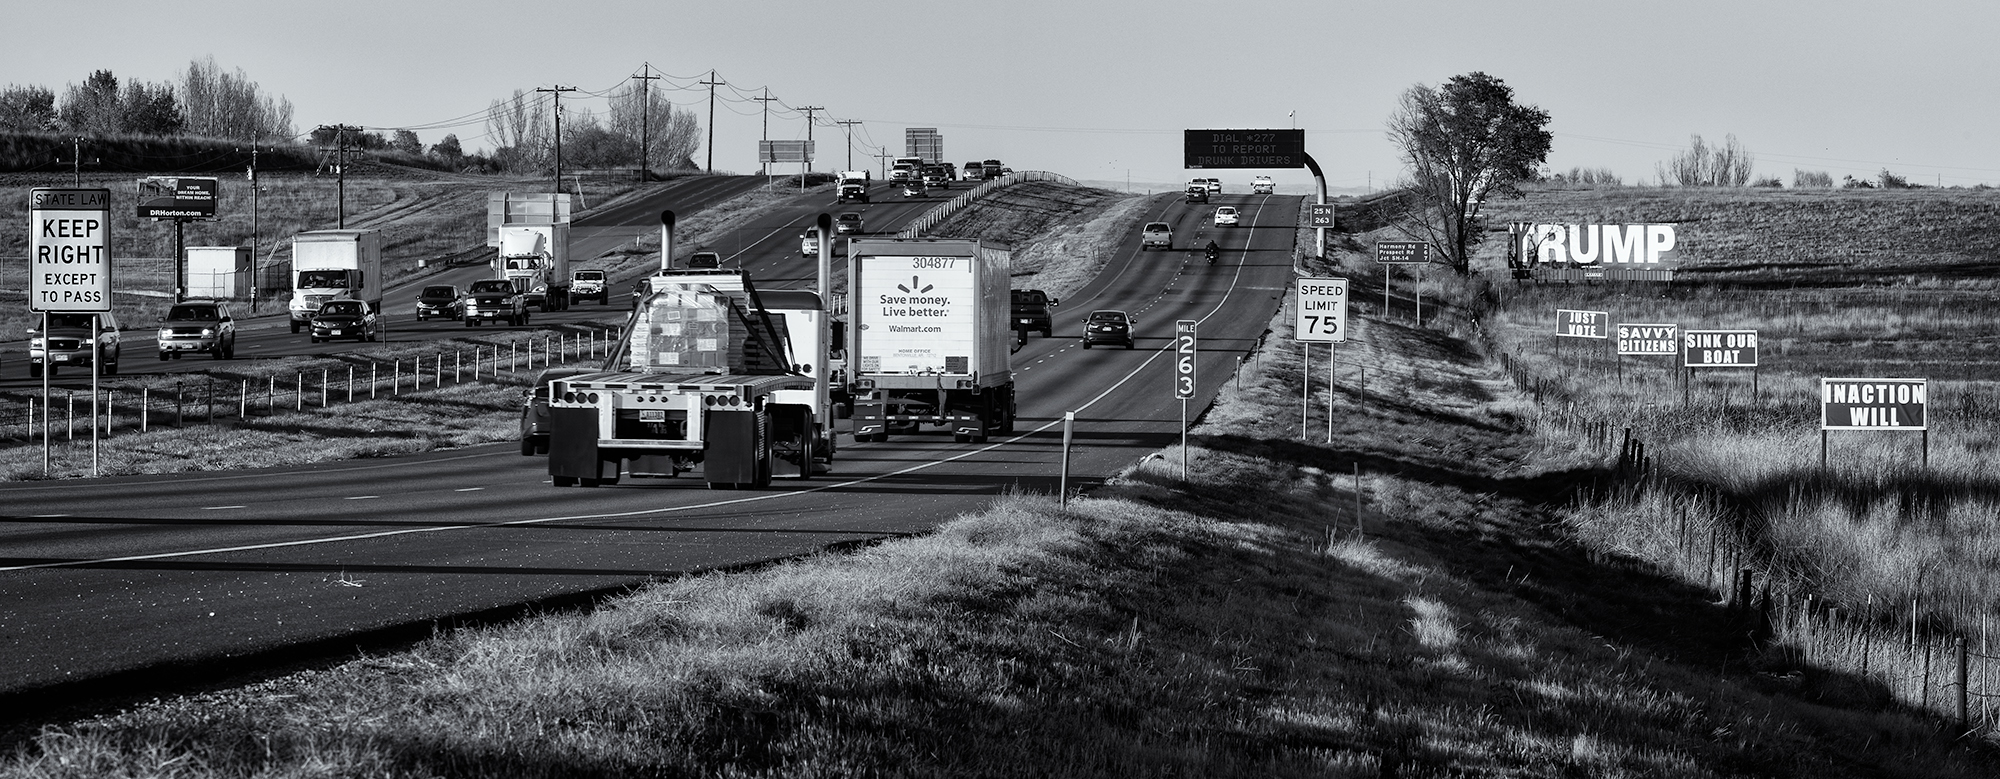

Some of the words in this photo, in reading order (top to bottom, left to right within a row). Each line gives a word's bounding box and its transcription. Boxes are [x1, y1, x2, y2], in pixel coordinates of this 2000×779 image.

[1212, 134, 1239, 142] DIAL
[1212, 145, 1226, 153] TO
[1233, 145, 1276, 153] REPORT
[1198, 156, 1234, 165] DRUNK
[1241, 156, 1290, 164] DRIVERS
[35, 193, 75, 205] STATE
[81, 193, 107, 205] LAW
[1315, 216, 1330, 224] 263
[43, 219, 99, 238] KEEP
[38, 245, 104, 264] RIGHT
[912, 257, 956, 269] 304877
[45, 273, 97, 285] EXCEPT
[41, 291, 58, 303] TO
[64, 291, 102, 303] PASS
[1301, 286, 1343, 296] SPEED
[880, 294, 907, 305] Save
[909, 296, 951, 307] money.
[1305, 301, 1338, 311] LIMIT
[883, 307, 907, 317] Live
[909, 307, 948, 317] better.
[1569, 312, 1597, 324] JUST
[888, 325, 942, 333] Walmart.com
[1178, 325, 1195, 333] MILE
[1304, 316, 1338, 334] 75
[1568, 325, 1597, 336] VOTE
[1619, 328, 1675, 338] SAVVY
[1620, 340, 1675, 351] CITIZENS
[1687, 334, 1721, 348] SINK
[1727, 334, 1756, 348] OUR
[1704, 350, 1740, 363] BOAT
[1178, 335, 1194, 395] 263
[1826, 384, 1924, 404] INACTION
[1850, 407, 1900, 426] WILL
